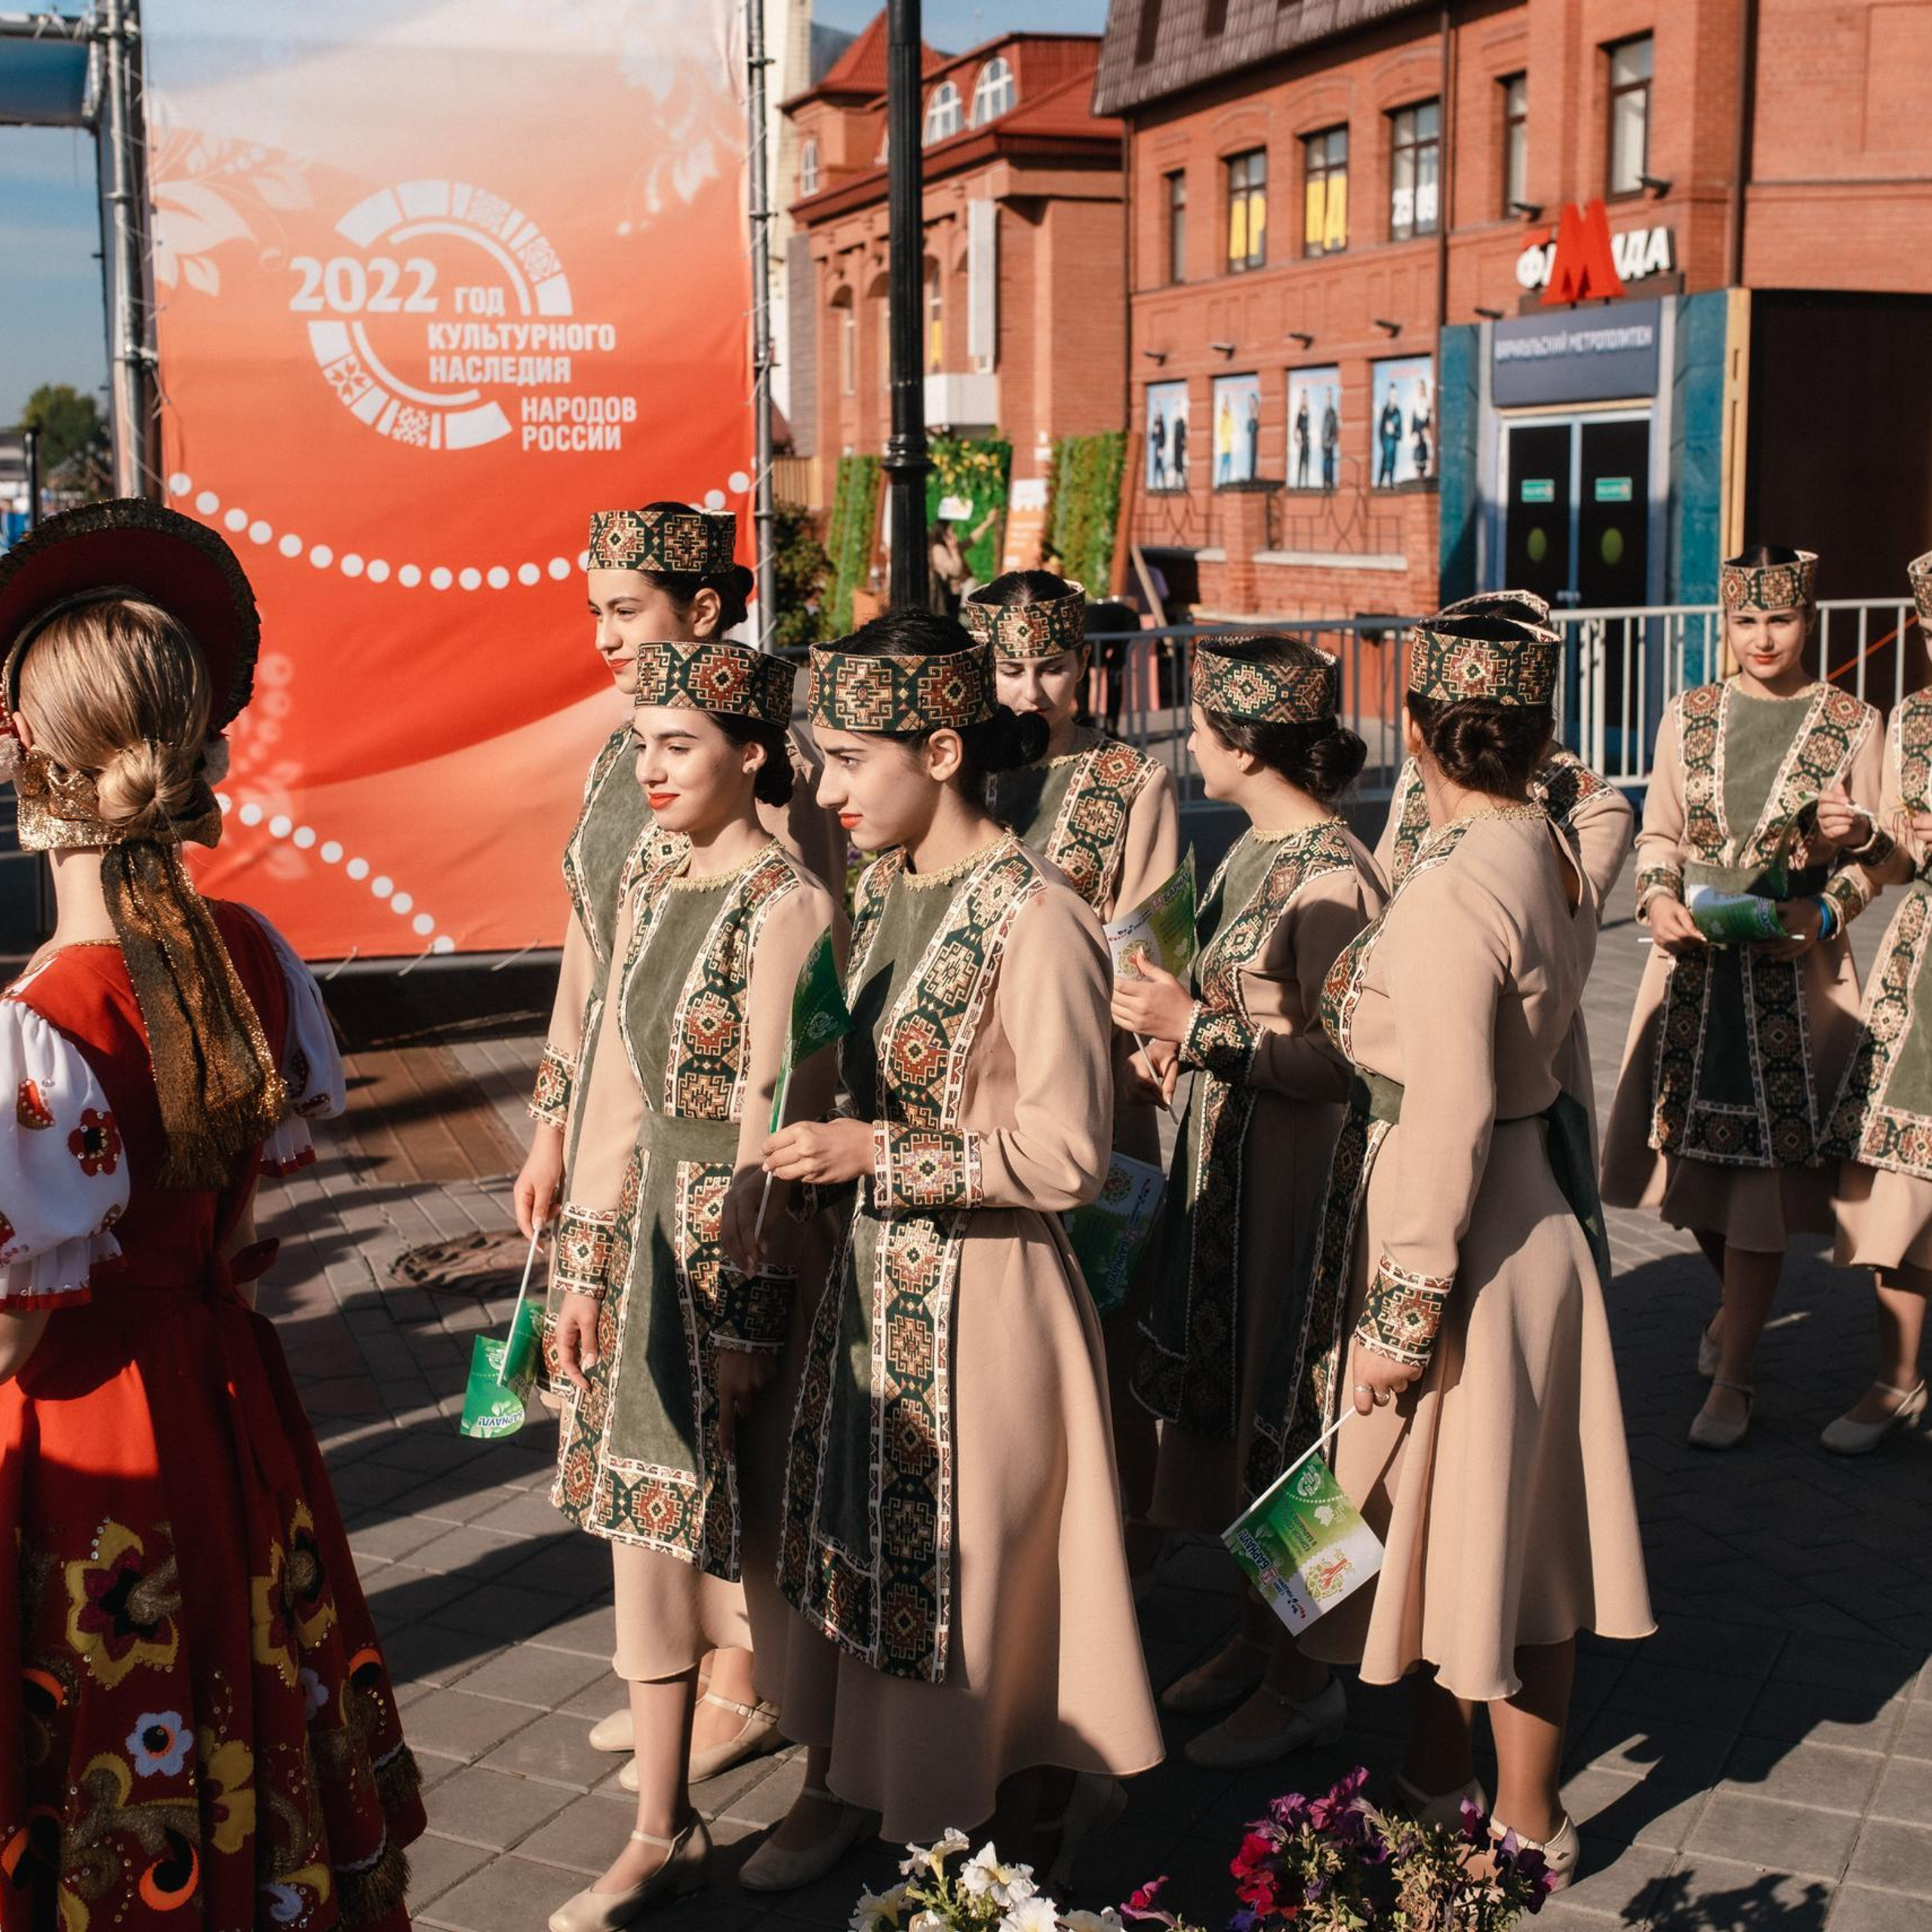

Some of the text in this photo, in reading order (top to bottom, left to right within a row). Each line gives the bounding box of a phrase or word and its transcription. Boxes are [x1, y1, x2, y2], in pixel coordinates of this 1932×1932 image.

[289, 257, 506, 316] 2022 ГОД
[427, 323, 616, 351] КУЛЬТУРНОГО
[429, 356, 571, 386] НАСЛЕДИЯ
[521, 397, 637, 424] НАРОДОВ
[522, 424, 621, 451] РОССИИ
[1236, 1529, 1270, 1569] БАРНАУЛ!
